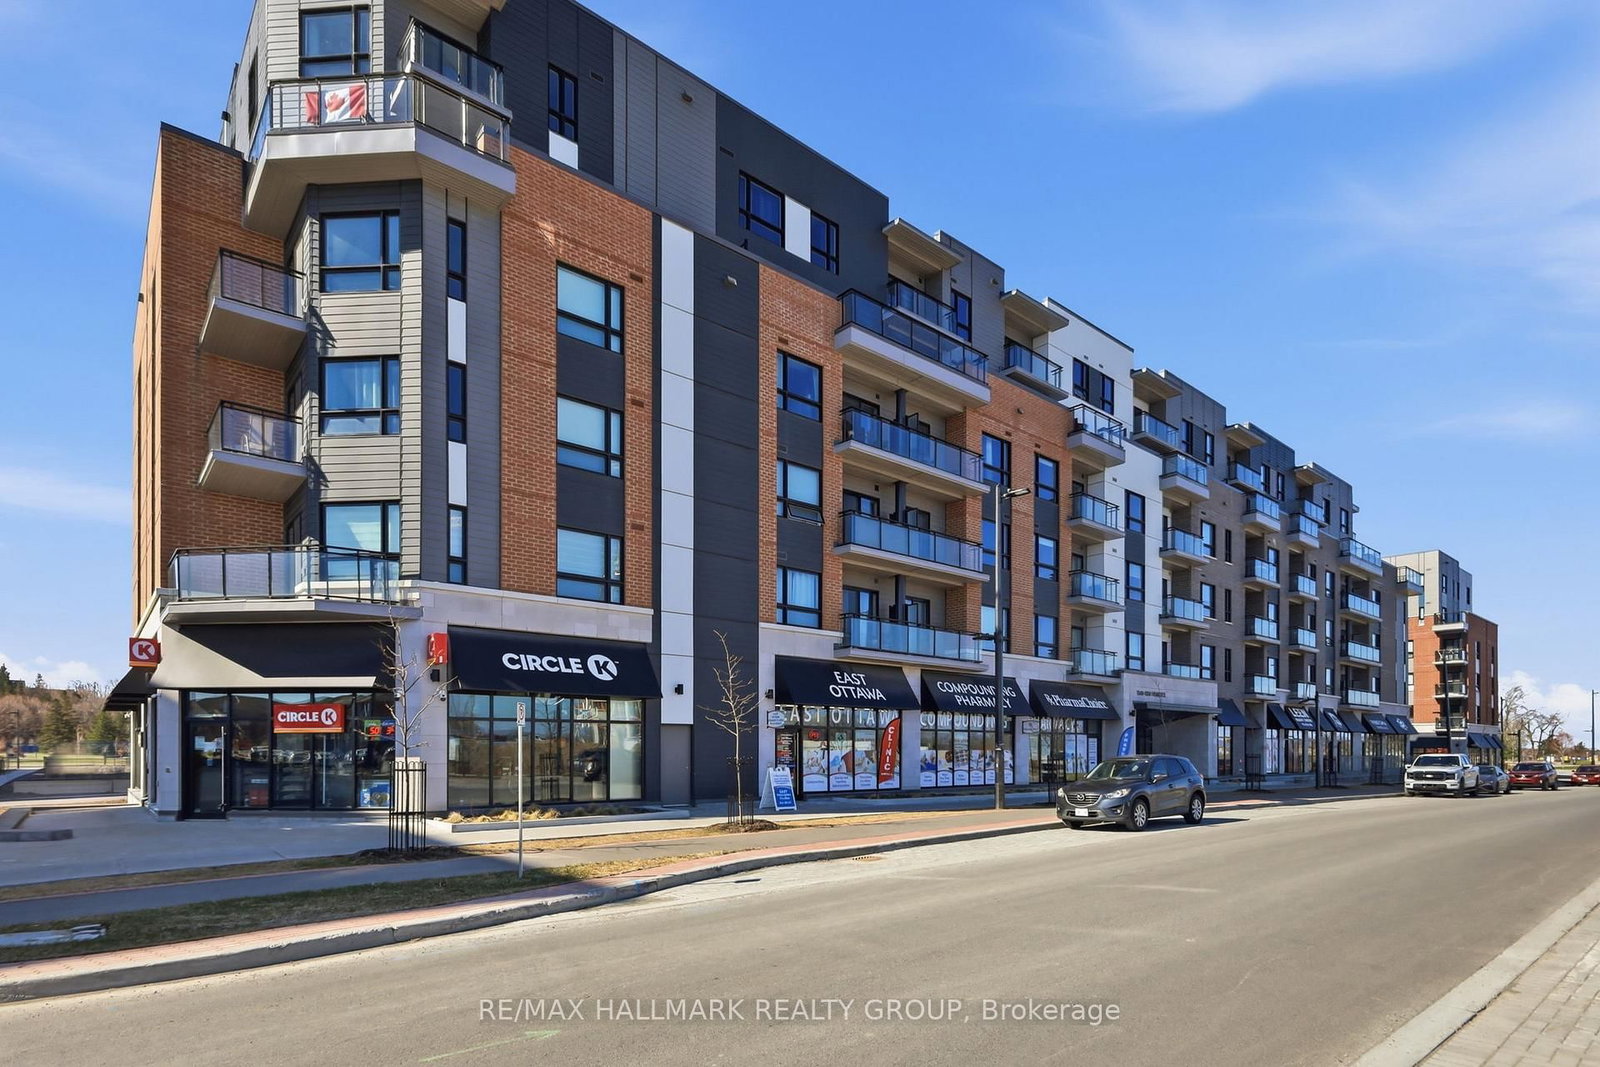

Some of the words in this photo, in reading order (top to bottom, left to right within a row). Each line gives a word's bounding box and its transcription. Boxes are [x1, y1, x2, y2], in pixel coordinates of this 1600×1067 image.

[502, 653, 584, 674] CIRCLE
[590, 656, 618, 680] K
[834, 672, 866, 686] EAST
[829, 685, 886, 700] OTTAWA
[954, 695, 1011, 708] PHARMY
[1051, 694, 1109, 709] PharmaChoice
[277, 711, 319, 722] CIRCLE
[322, 709, 337, 725] K
[884, 726, 895, 771] CLINIC
